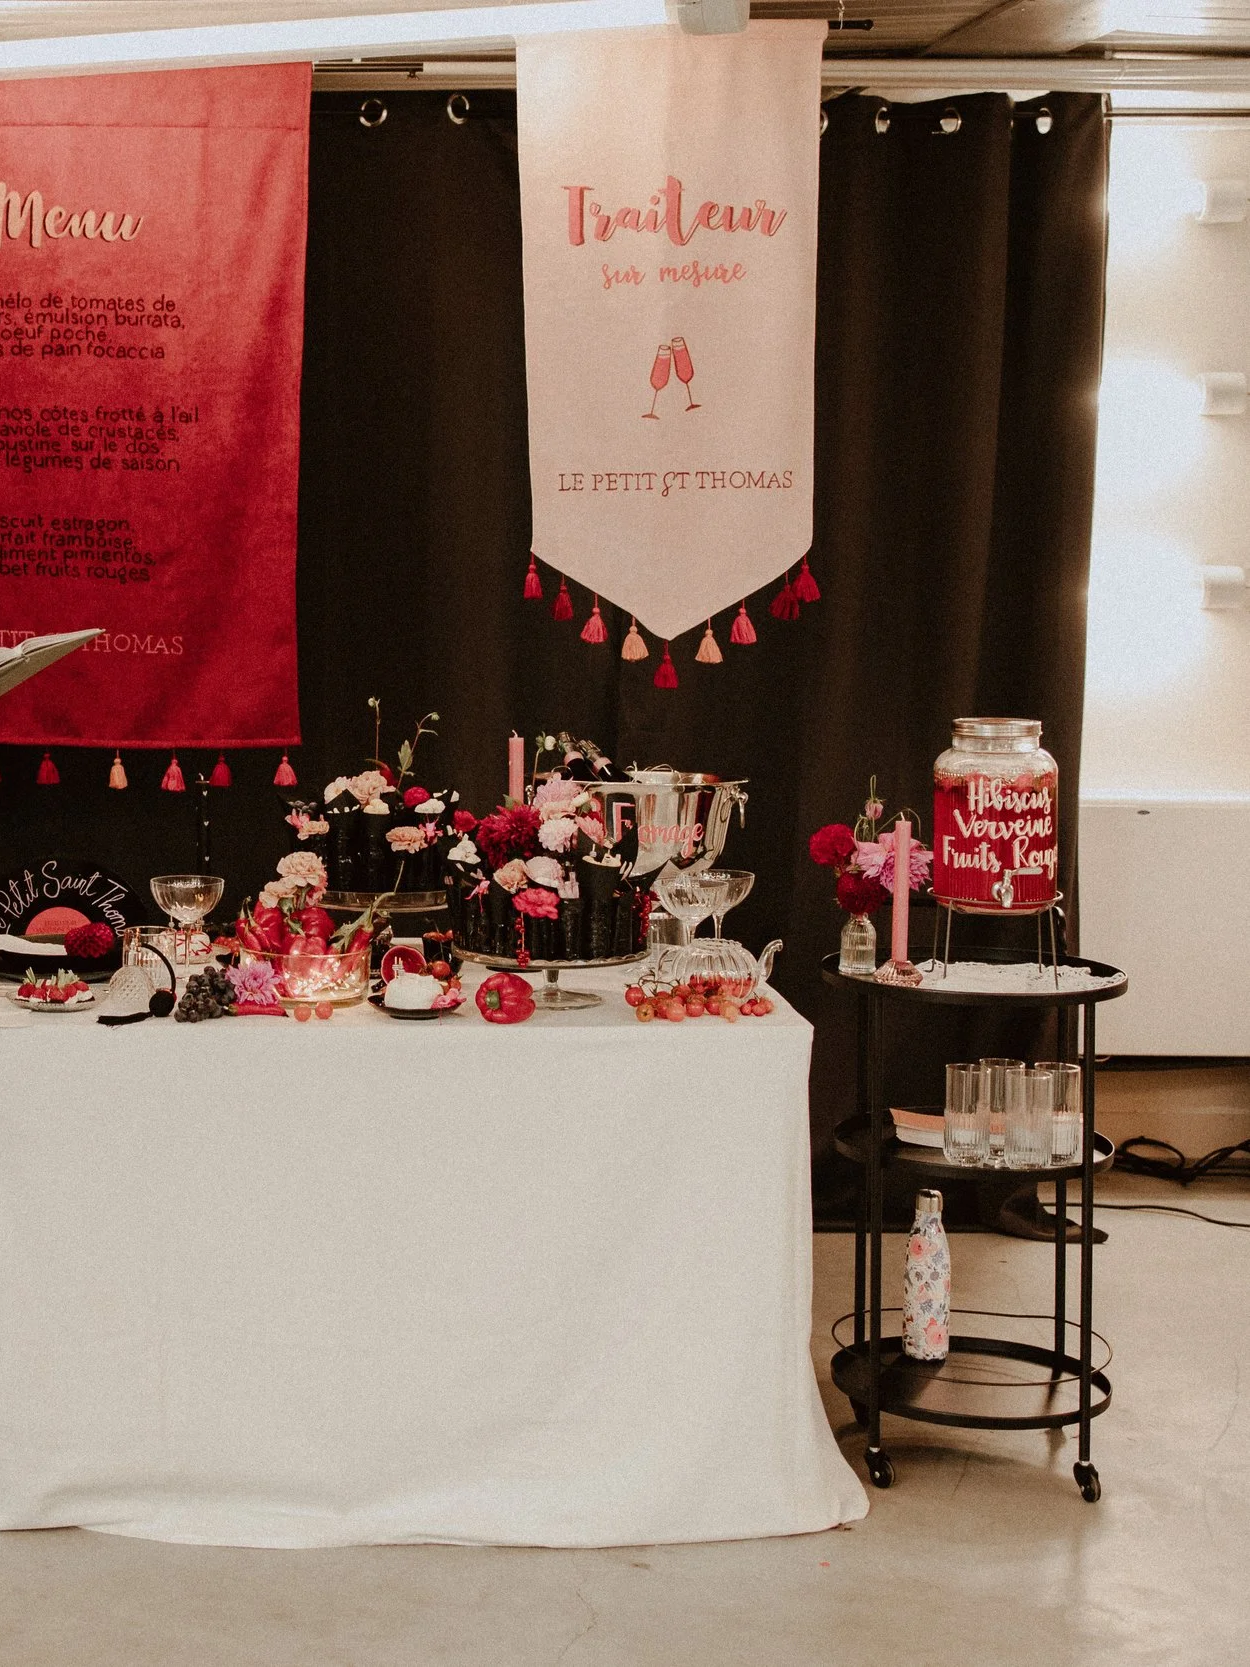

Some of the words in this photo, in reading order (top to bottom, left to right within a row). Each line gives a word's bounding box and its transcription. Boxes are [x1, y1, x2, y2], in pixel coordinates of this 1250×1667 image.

[561, 175, 787, 247] Traiteur
[602, 263, 646, 290] sur
[659, 260, 748, 288] mesure
[40, 292, 63, 309] de
[71, 295, 145, 313] tomates
[152, 293, 176, 312] de
[24, 308, 108, 325] émulsion
[114, 310, 186, 330] burrata,
[0, 324, 44, 341] oeuf
[10, 340, 35, 357] de
[41, 342, 82, 360] pain
[87, 341, 166, 360] focaccia
[95, 405, 146, 422] frotté
[171, 405, 199, 424] l'ail
[58, 421, 81, 437] de
[88, 423, 181, 442] crustacés,
[71, 439, 95, 453] sur
[104, 437, 118, 453] le
[5, 449, 84, 474] légumes
[90, 451, 111, 470] de
[121, 458, 180, 473] saison
[558, 473, 585, 492] LE
[592, 472, 658, 491] PETIT
[695, 470, 794, 492] THOMAS
[35, 561, 81, 578] fruits
[87, 565, 150, 585] rouges
[967, 776, 1053, 815] Hibiscus
[612, 801, 706, 859] Fomage
[953, 808, 1054, 842] Verveine
[942, 834, 1003, 873] Fruits
[41, 860, 103, 899] Saint
[91, 878, 128, 939] Thoma
